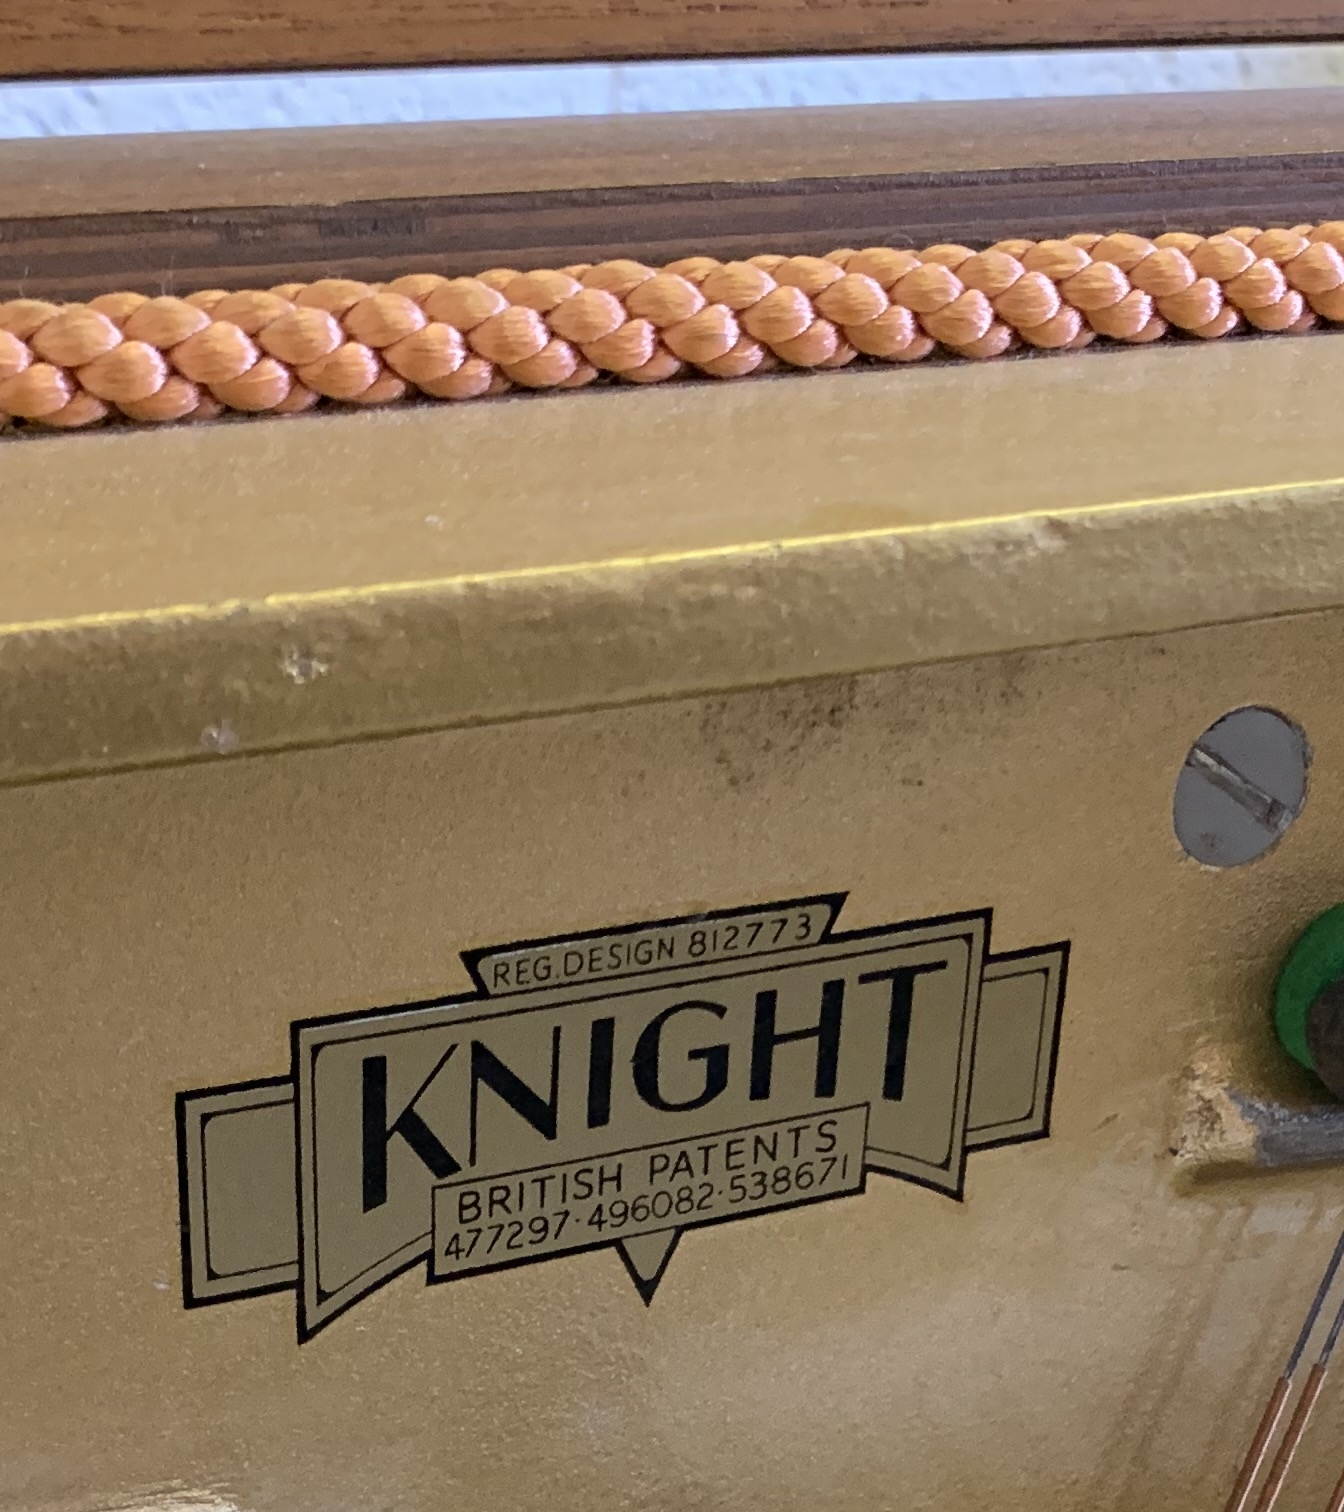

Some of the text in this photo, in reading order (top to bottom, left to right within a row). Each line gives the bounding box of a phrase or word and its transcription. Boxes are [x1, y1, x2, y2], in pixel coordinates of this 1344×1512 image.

[687, 912, 812, 958] 812773
[361, 960, 948, 1214] KNIGHT
[457, 1119, 838, 1224] BRITISH PATENTS
